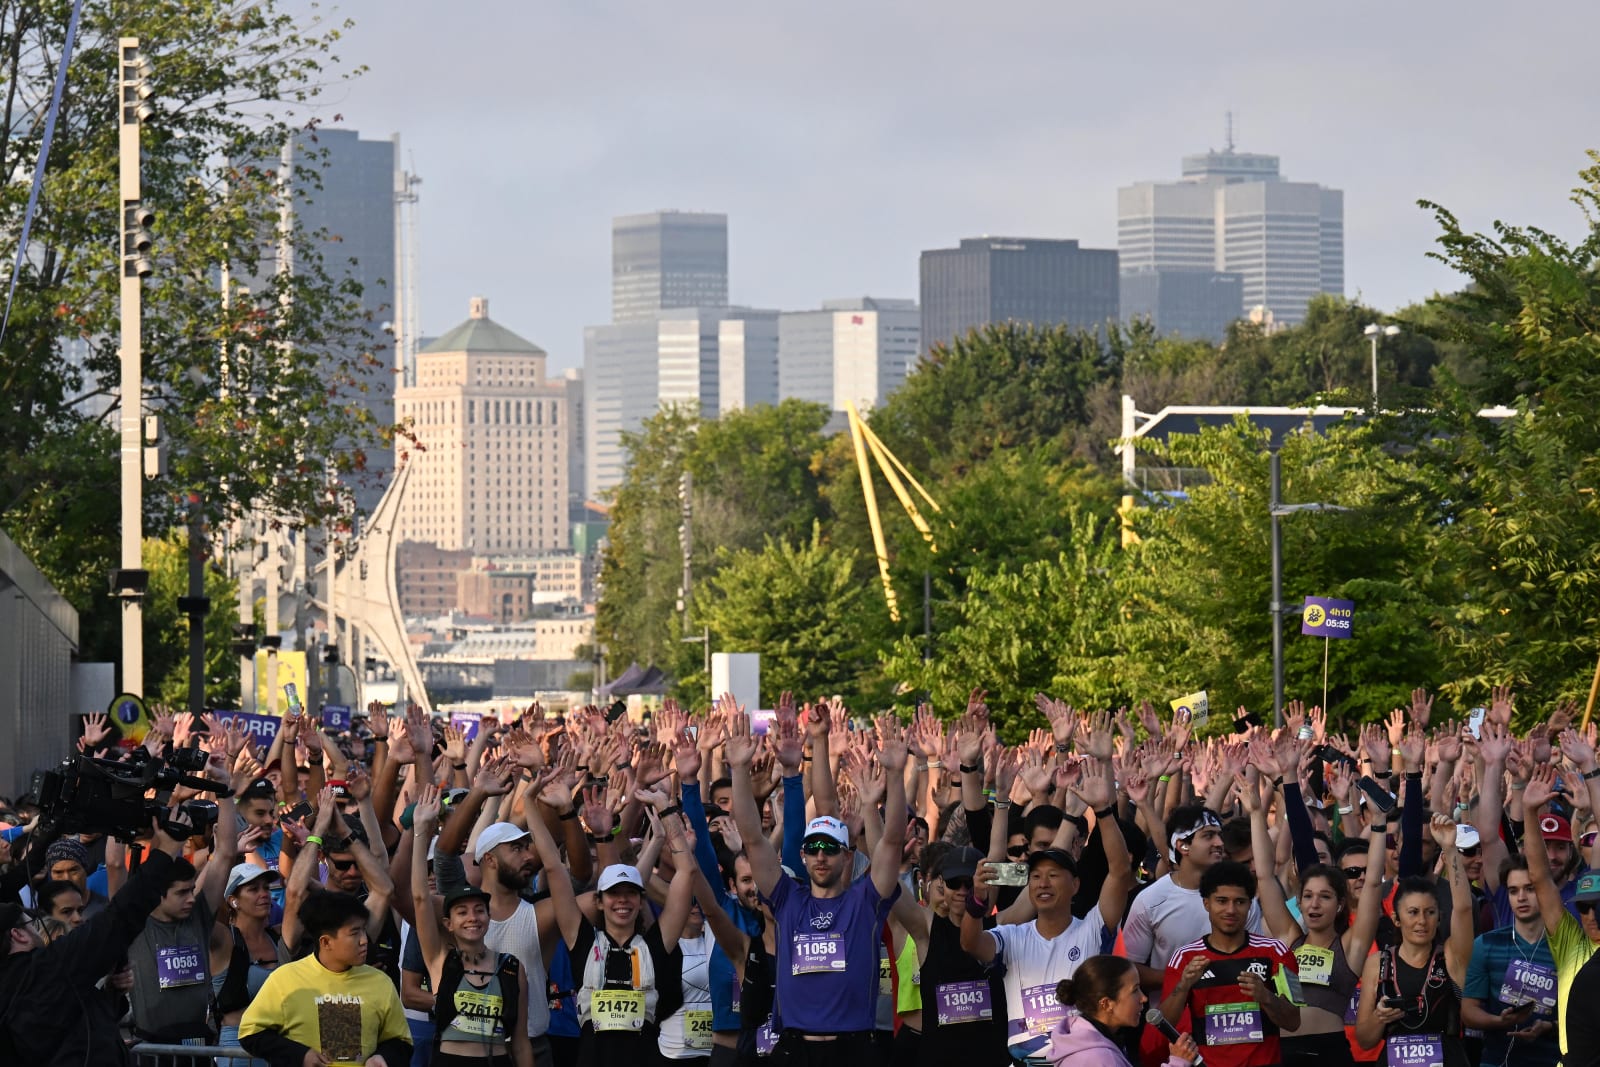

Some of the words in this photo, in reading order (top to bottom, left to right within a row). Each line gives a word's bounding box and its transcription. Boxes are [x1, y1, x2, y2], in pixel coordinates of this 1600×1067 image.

[1329, 608, 1351, 617] 4h10
[1325, 619, 1350, 629] 05:55
[331, 713, 342, 726] 8
[461, 721, 473, 735] 7
[796, 941, 837, 957] 11058
[165, 955, 198, 970] 10583
[1515, 969, 1554, 991] 10980
[943, 990, 984, 1006] 13043
[459, 1001, 500, 1017] 27613
[597, 1000, 638, 1013] 21472
[691, 1020, 713, 1032] 245
[1212, 1012, 1254, 1028] 11746
[1394, 1044, 1434, 1059] 11203
[1402, 1057, 1426, 1065] Isabelle
